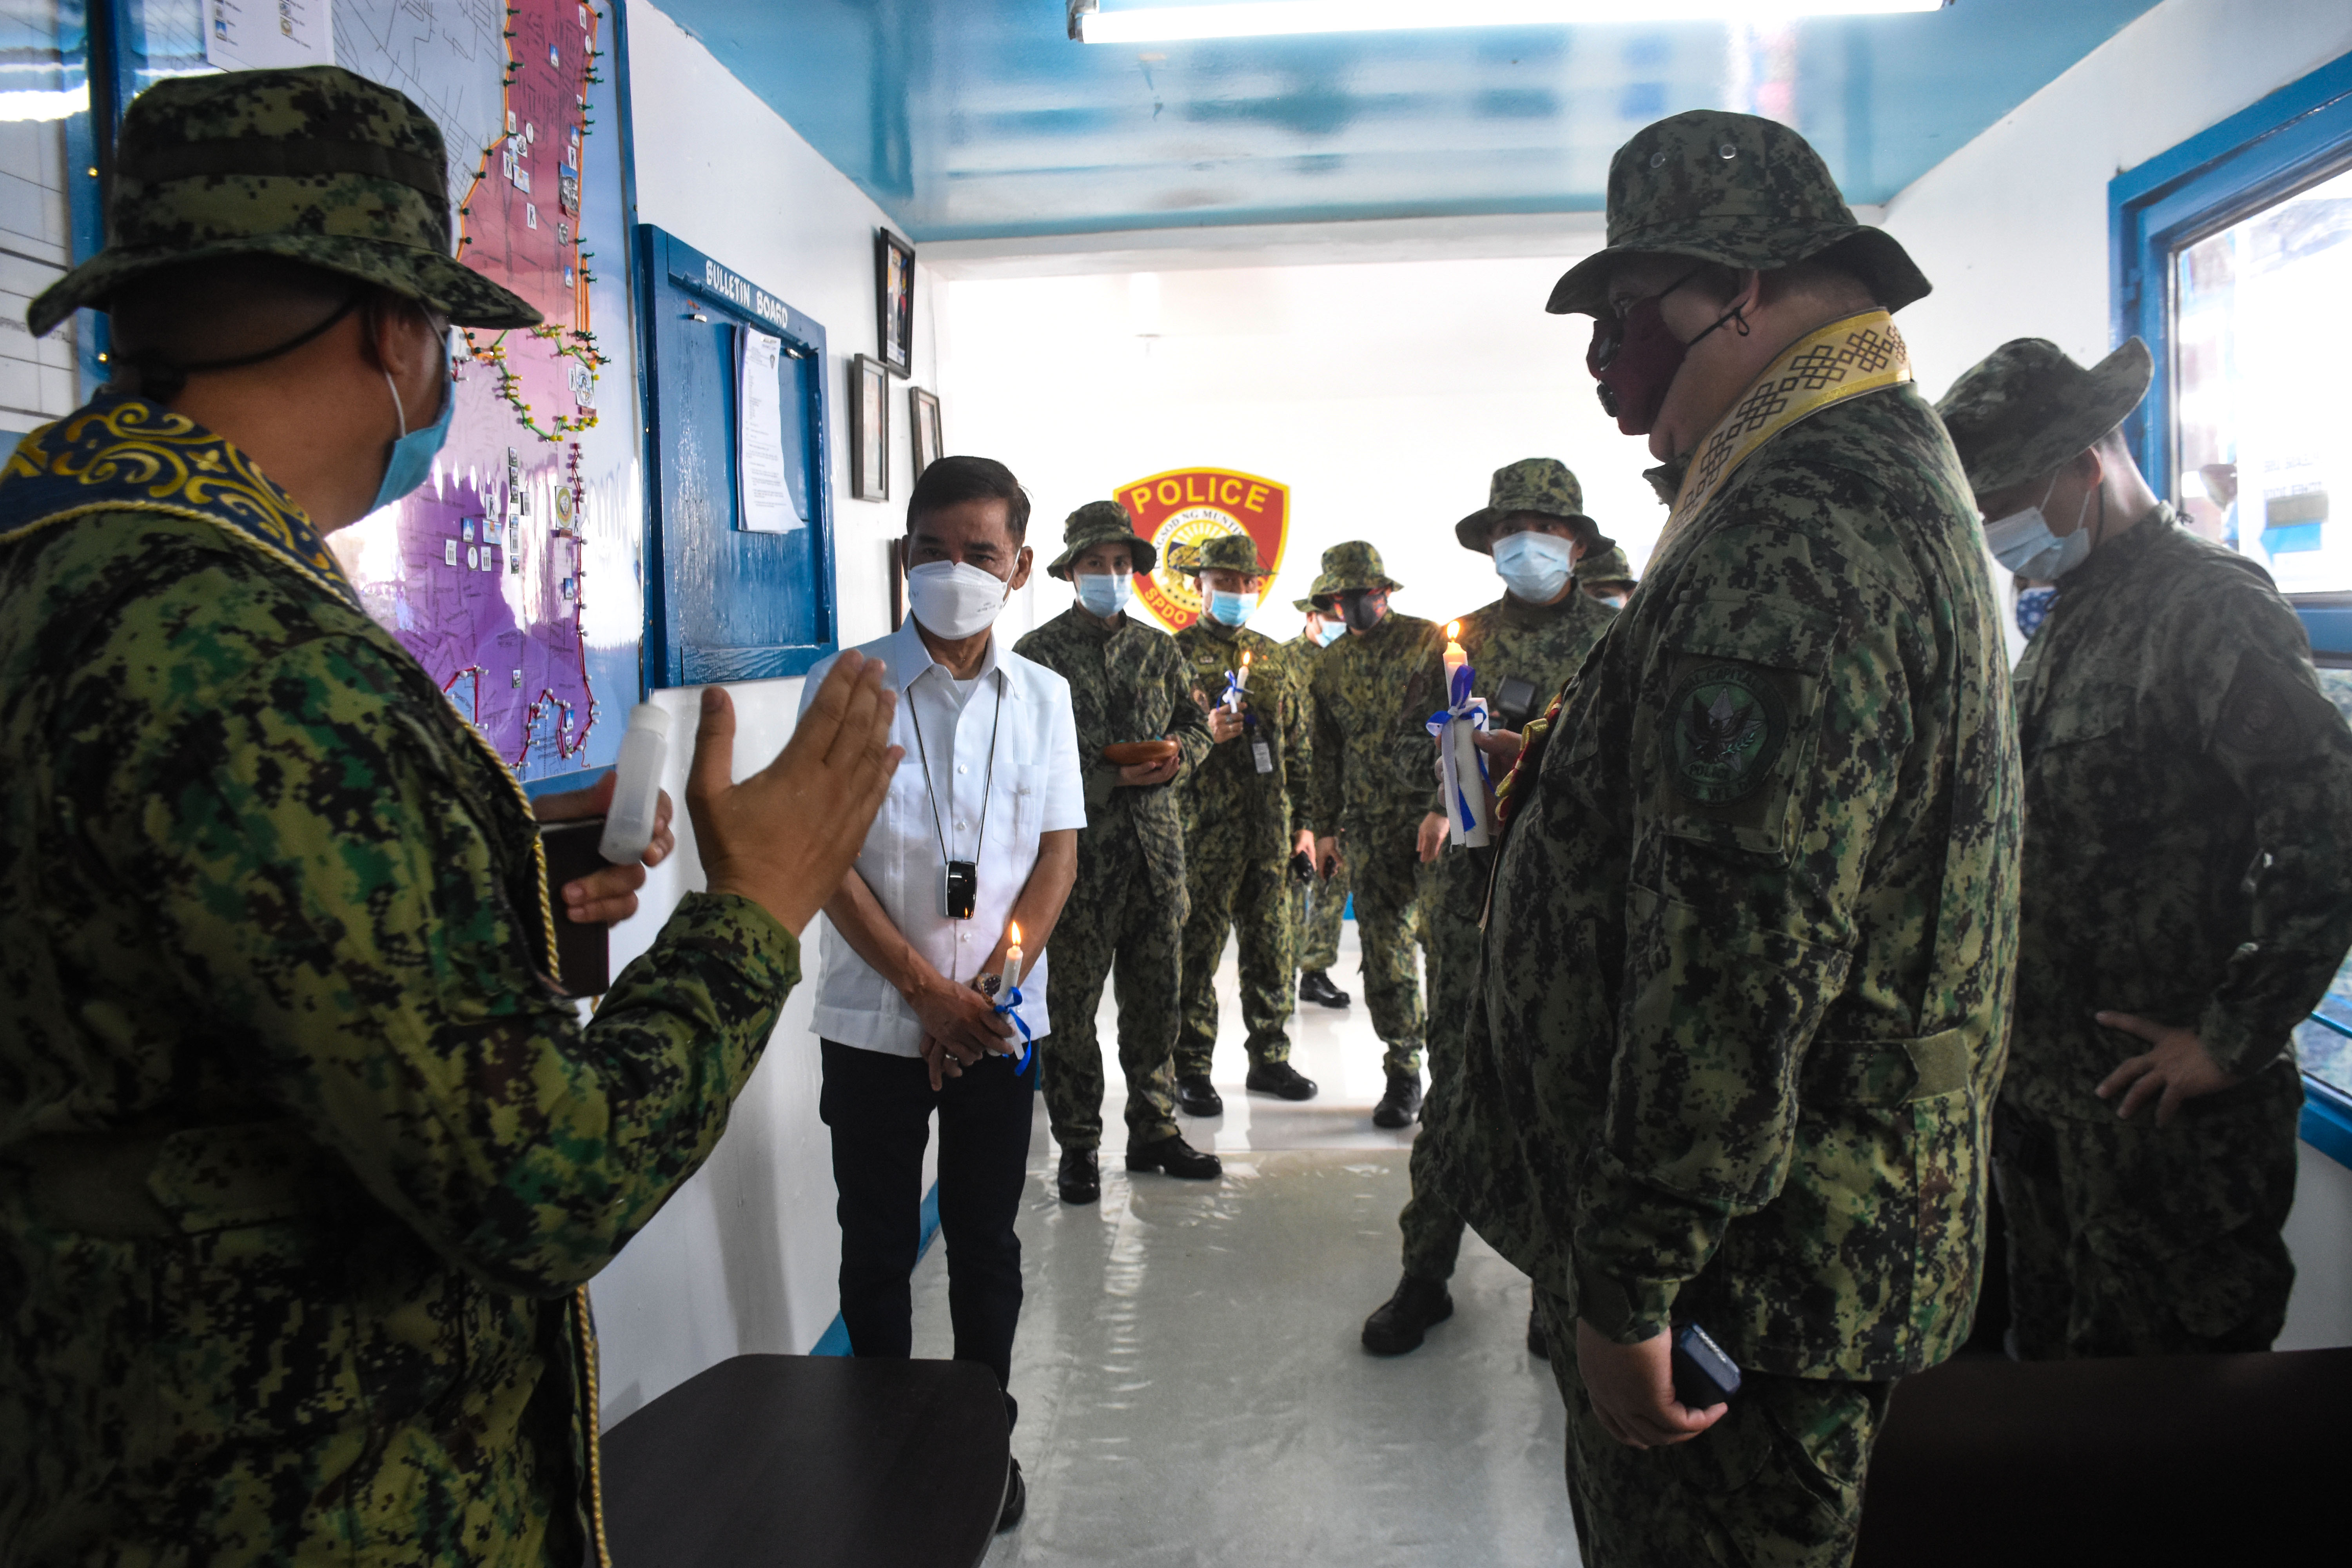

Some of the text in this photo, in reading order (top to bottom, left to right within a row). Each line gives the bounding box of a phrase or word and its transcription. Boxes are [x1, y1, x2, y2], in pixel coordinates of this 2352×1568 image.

[706, 260, 788, 328] BULLETIN BOARD
[1130, 477, 1270, 514] POLICE
[1182, 510, 1198, 518] NG
[1145, 588, 1188, 624] SPDO
